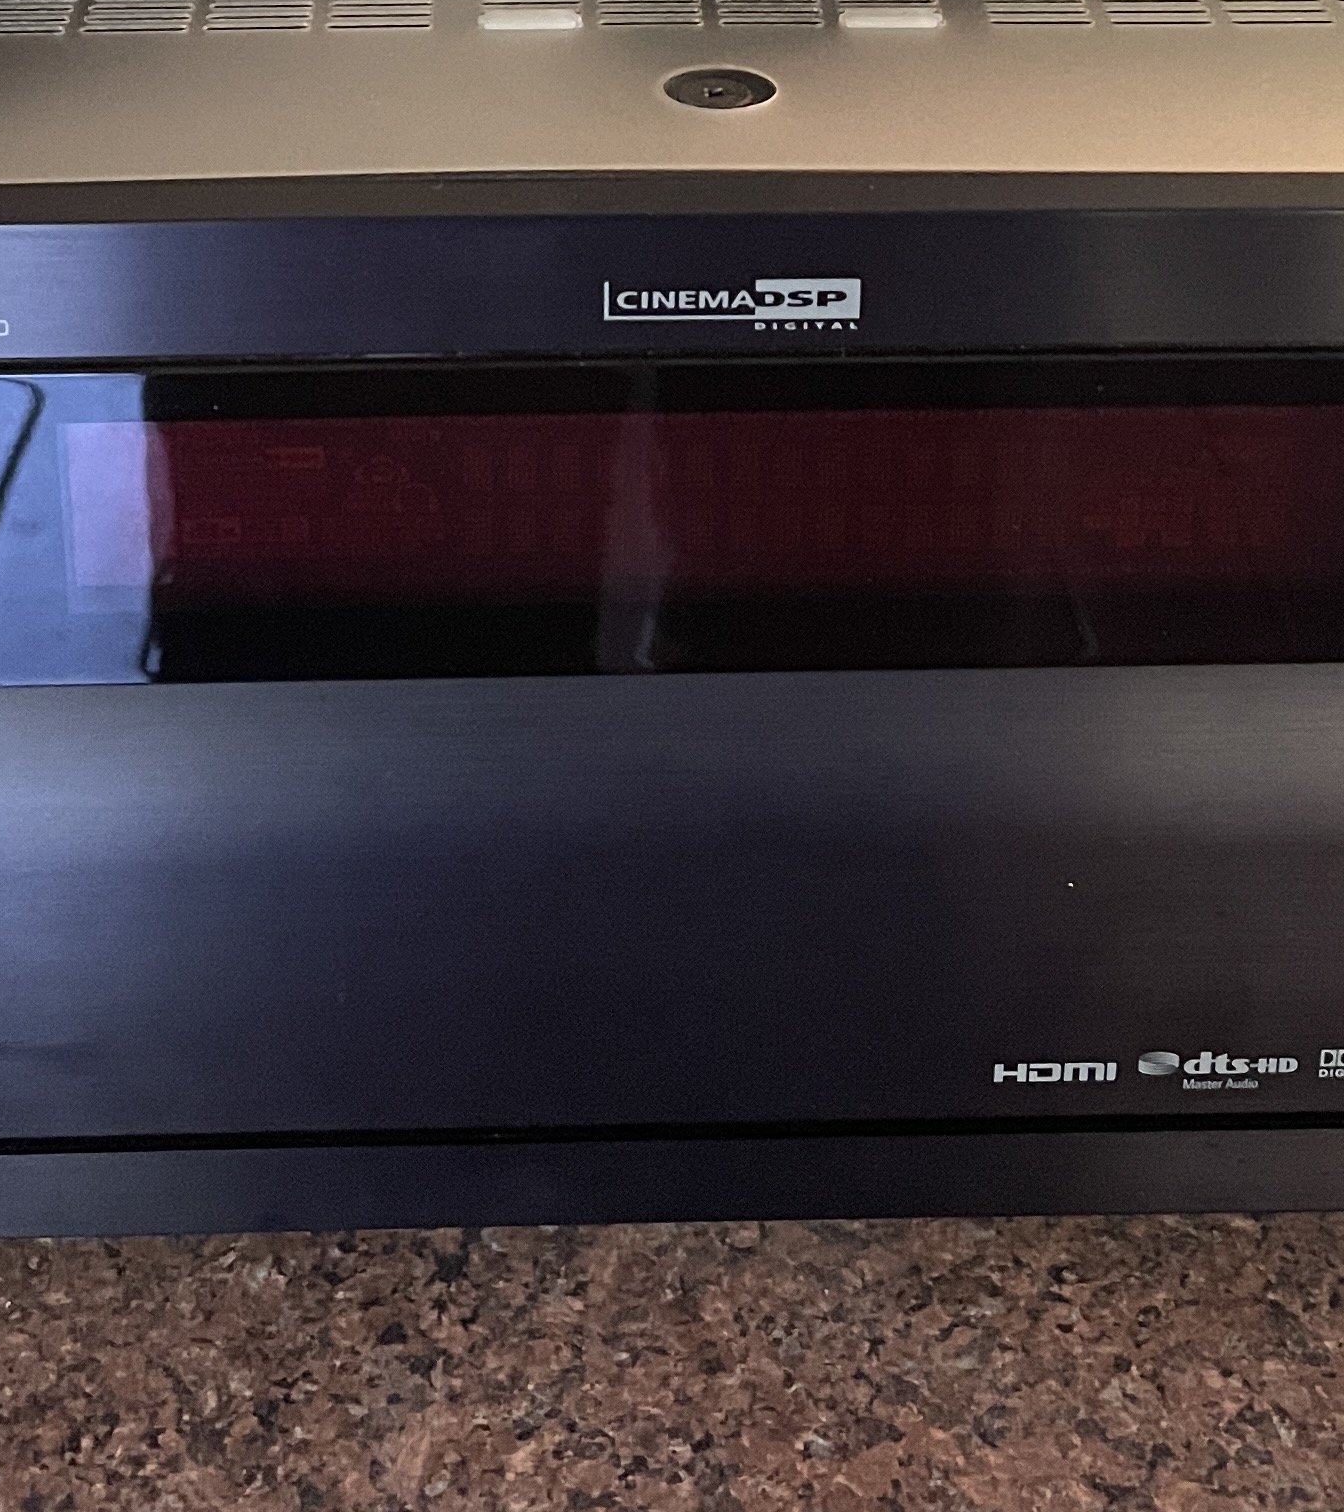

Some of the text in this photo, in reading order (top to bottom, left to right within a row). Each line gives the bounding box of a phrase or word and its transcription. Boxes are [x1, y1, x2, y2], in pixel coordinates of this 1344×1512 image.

[754, 321, 858, 331] DIGITAL
[1183, 1051, 1299, 1076] dts-HD
[993, 1062, 1117, 1084] HDMI
[1182, 1077, 1259, 1090] Master Audio
